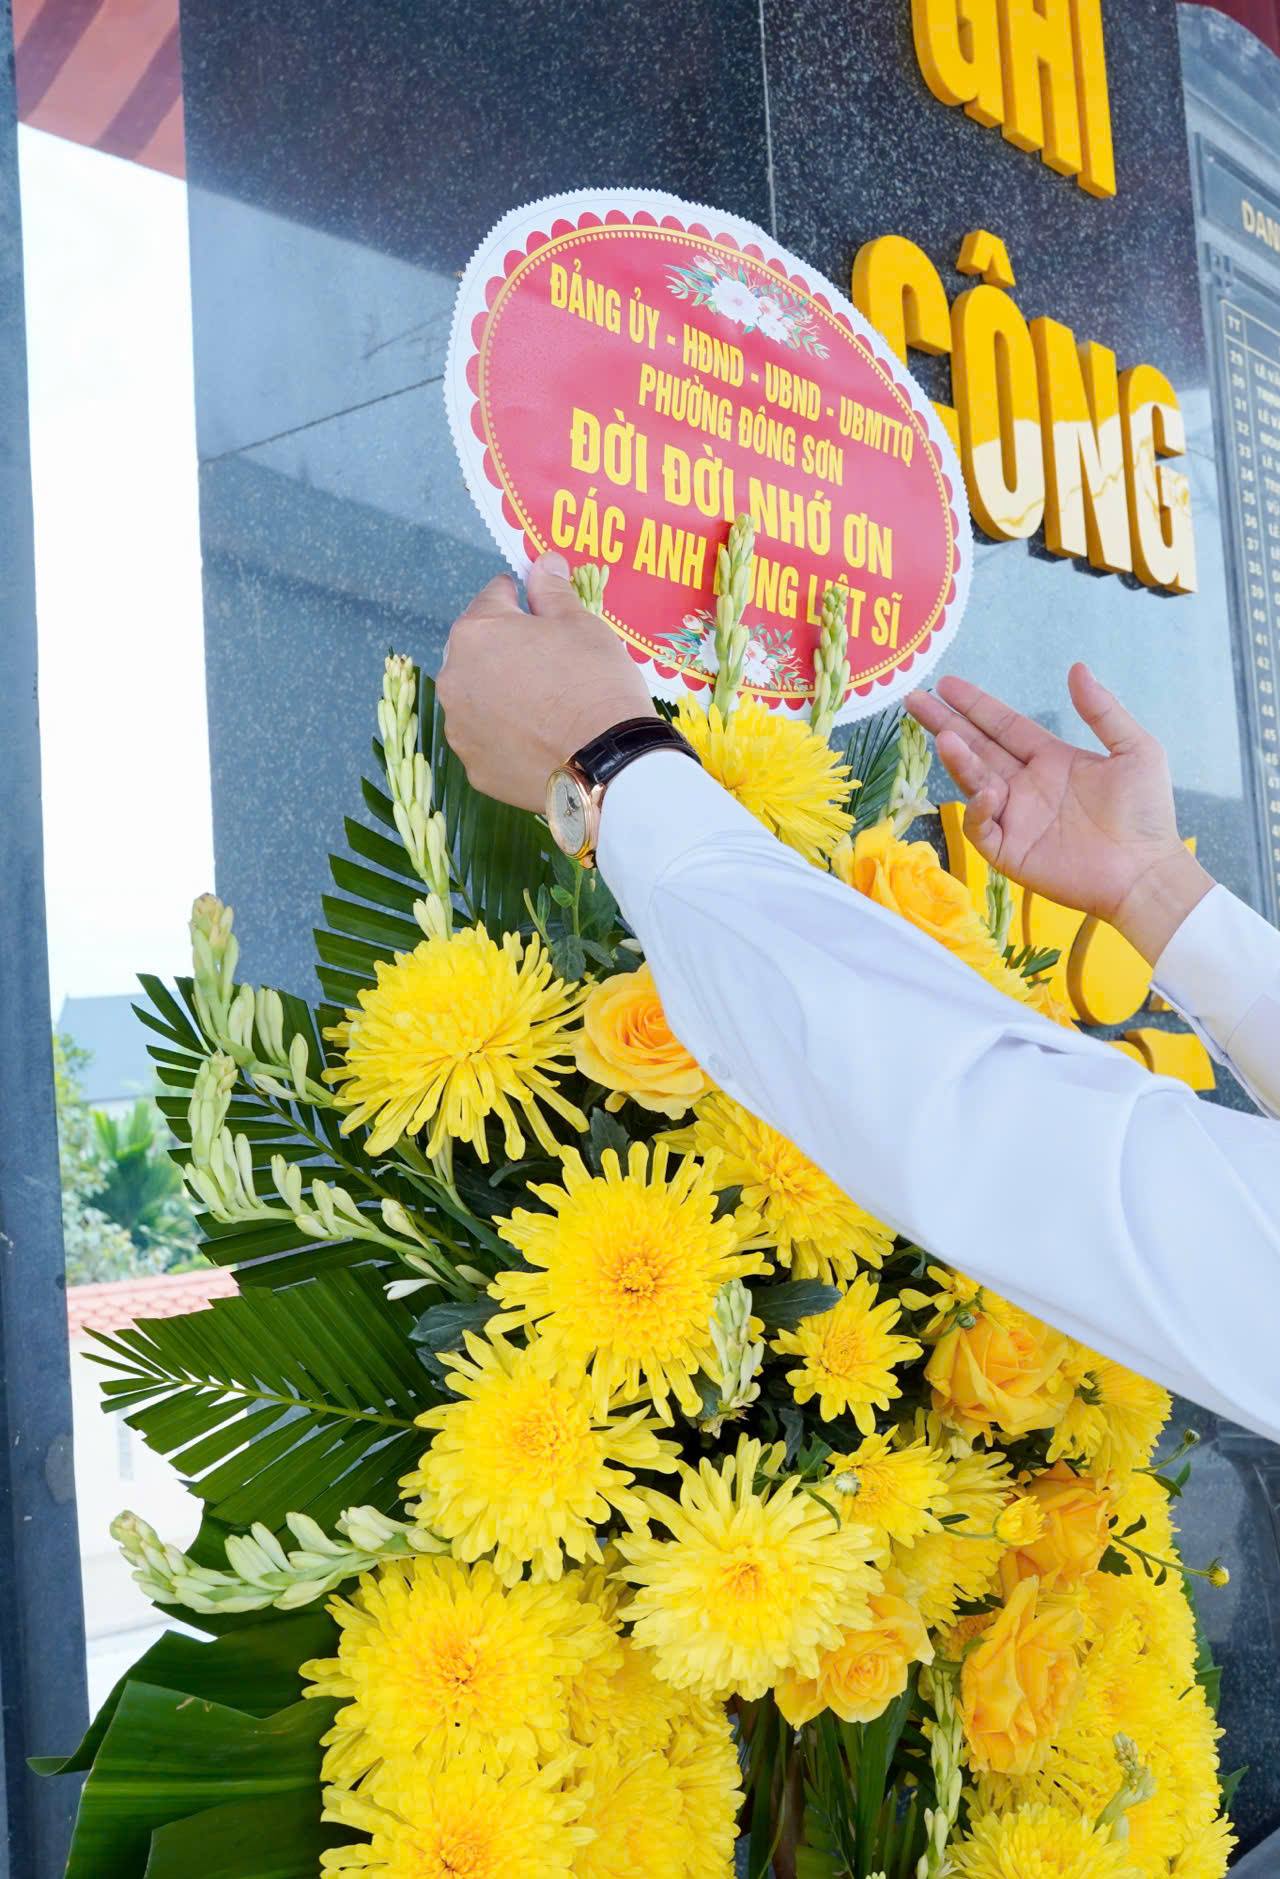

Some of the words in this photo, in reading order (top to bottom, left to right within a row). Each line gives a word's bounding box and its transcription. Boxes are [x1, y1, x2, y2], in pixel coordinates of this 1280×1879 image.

[549, 258, 621, 336] ĐẢNG
[628, 286, 661, 352] ỦY
[683, 323, 745, 389] HĐND
[764, 360, 822, 423] UBND
[838, 394, 914, 468] UBMTTQ
[638, 362, 731, 447] PHƯỜNG
[738, 405, 796, 466] ĐÔNG
[801, 439, 844, 487] SƠN
[550, 483, 625, 564] CÁC
[633, 516, 706, 591] ANH
[871, 591, 904, 650] SĨ
[569, 406, 648, 494] ĐỜI
[661, 444, 736, 525] ĐỜI
[749, 476, 833, 557] NHỚ
[843, 511, 893, 580] ƠN
